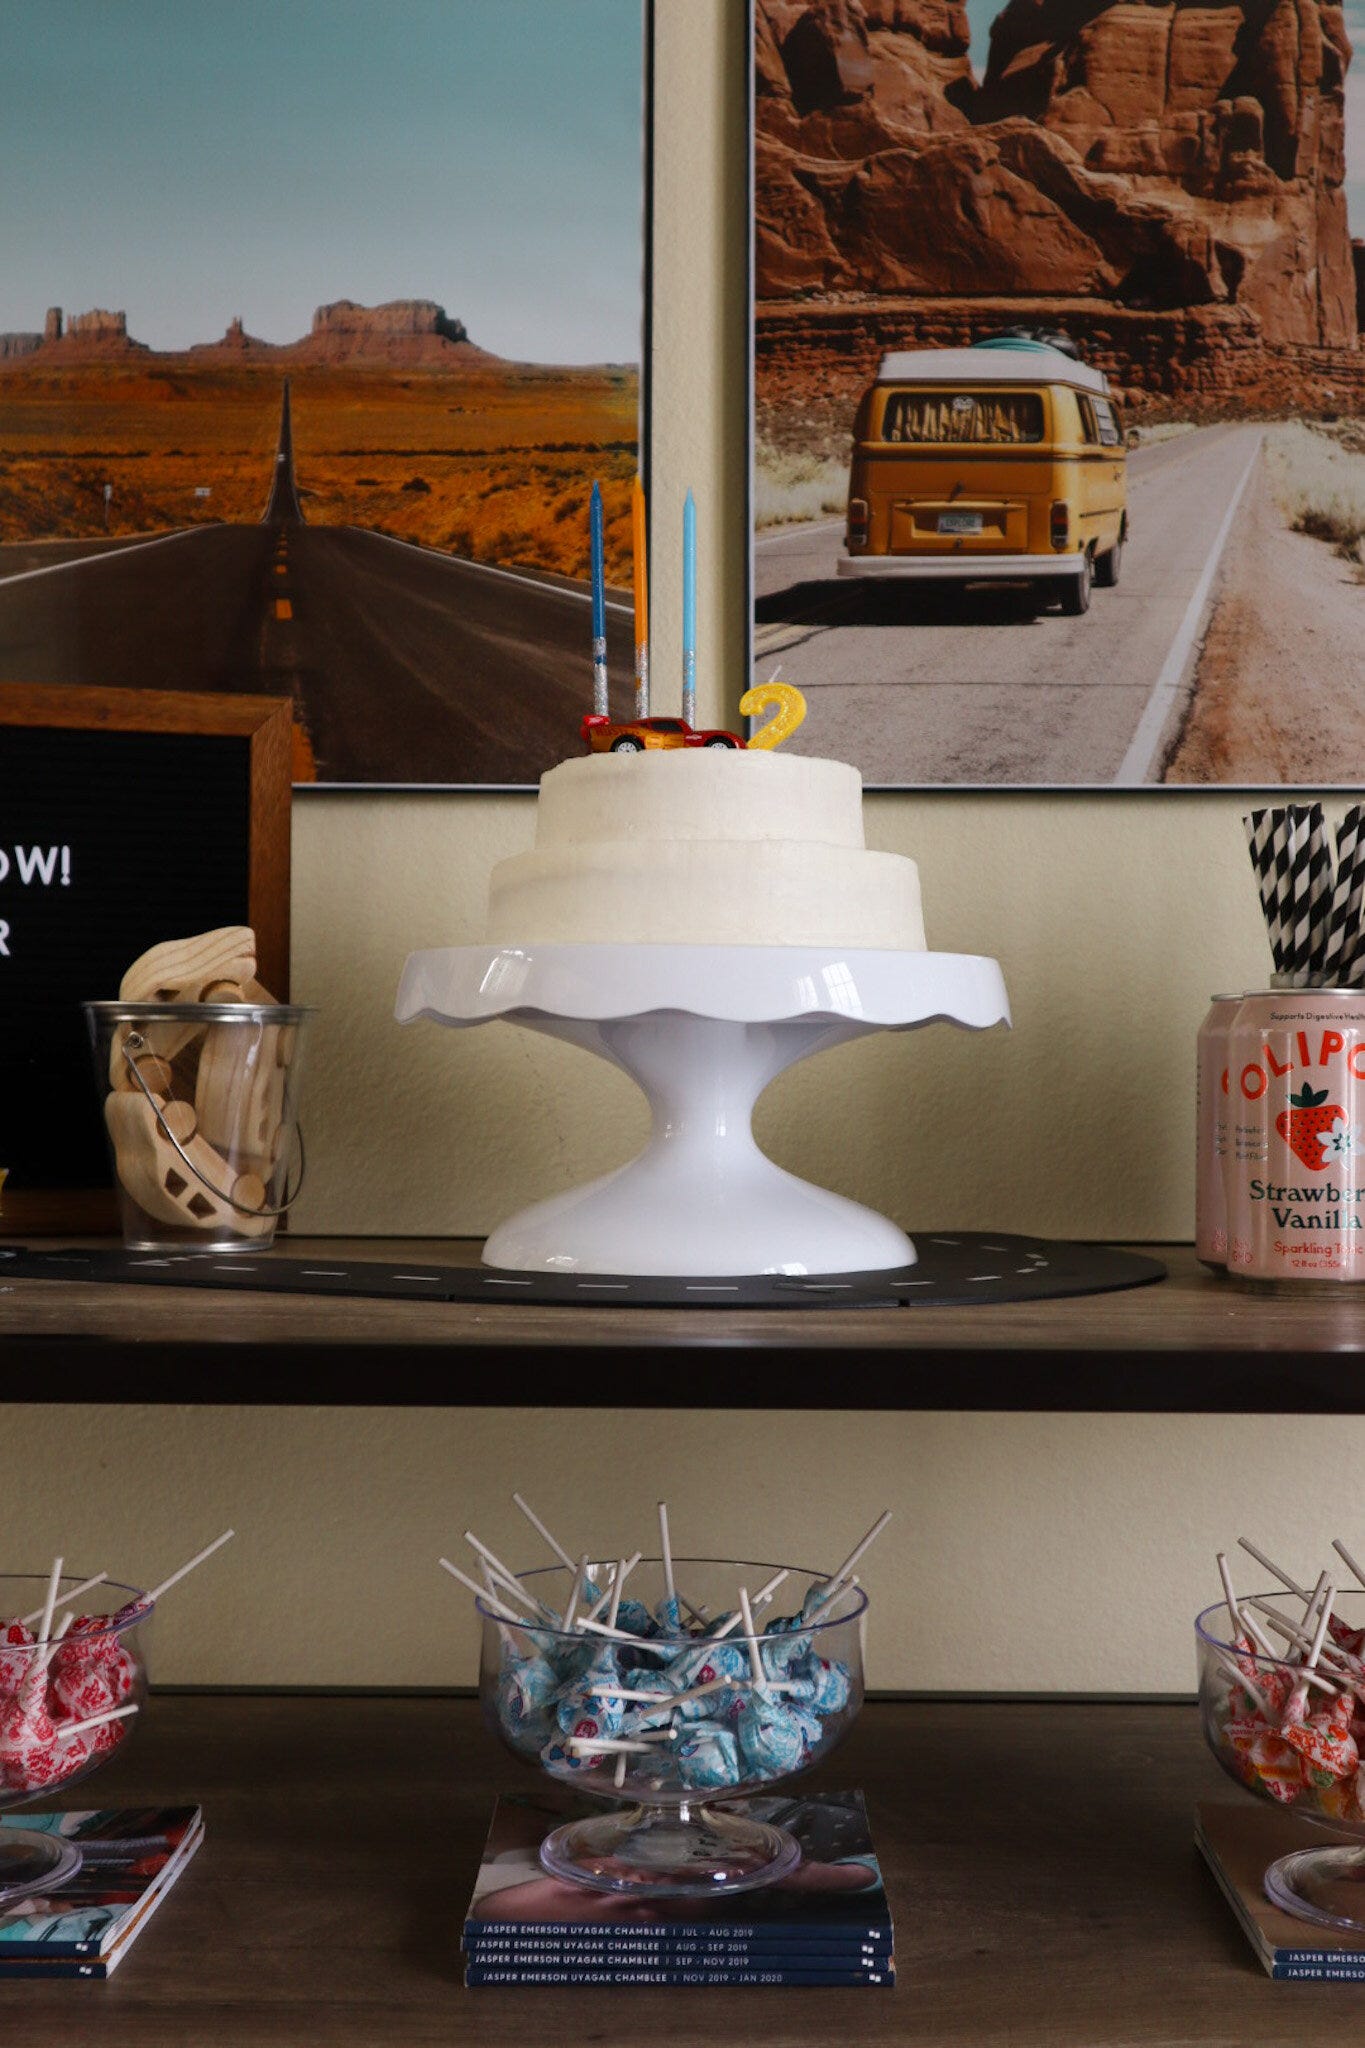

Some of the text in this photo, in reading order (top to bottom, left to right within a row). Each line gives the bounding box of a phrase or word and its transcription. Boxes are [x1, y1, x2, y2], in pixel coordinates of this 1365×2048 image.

[1272, 1206, 1362, 1229] Vanilla
[1274, 1241, 1333, 1258] Sparkling
[483, 1925, 517, 1934] JASPER
[521, 1925, 568, 1934] EMERSON
[571, 1926, 611, 1935] UYAGAK
[615, 1927, 666, 1936] CHAMBLEE
[682, 1928, 698, 1937] JUL
[709, 1928, 730, 1937] AUG
[734, 1929, 754, 1938] 2019
[477, 1940, 511, 1949] JASPER
[514, 1940, 561, 1949] EMERSON
[563, 1941, 604, 1950] UYAGAK
[608, 1942, 659, 1951] CHAMBLEE
[676, 1942, 697, 1951] AUG
[708, 1943, 724, 1952] SEP
[728, 1943, 748, 1952] 2019
[476, 1954, 511, 1963] JASPER
[514, 1954, 560, 1964] EMERSON
[563, 1955, 604, 1965] UYAGAK
[608, 1955, 659, 1966] CHAMBLEE
[677, 1956, 693, 1966] SEP
[704, 1957, 725, 1966] NOV
[729, 1957, 750, 1967] 2019
[1290, 1953, 1324, 1962] JASPER
[484, 1973, 518, 1981] JASPER
[522, 1973, 568, 1982] EMERSON
[571, 1973, 612, 1982] UYAGAK
[615, 1973, 667, 1982] CHAMBLEE
[684, 1973, 705, 1982] NOV
[709, 1973, 729, 1982] 2019
[739, 1973, 757, 1982] JAN
[760, 1974, 782, 1983] 2020
[1289, 1968, 1322, 1977] JASPER
